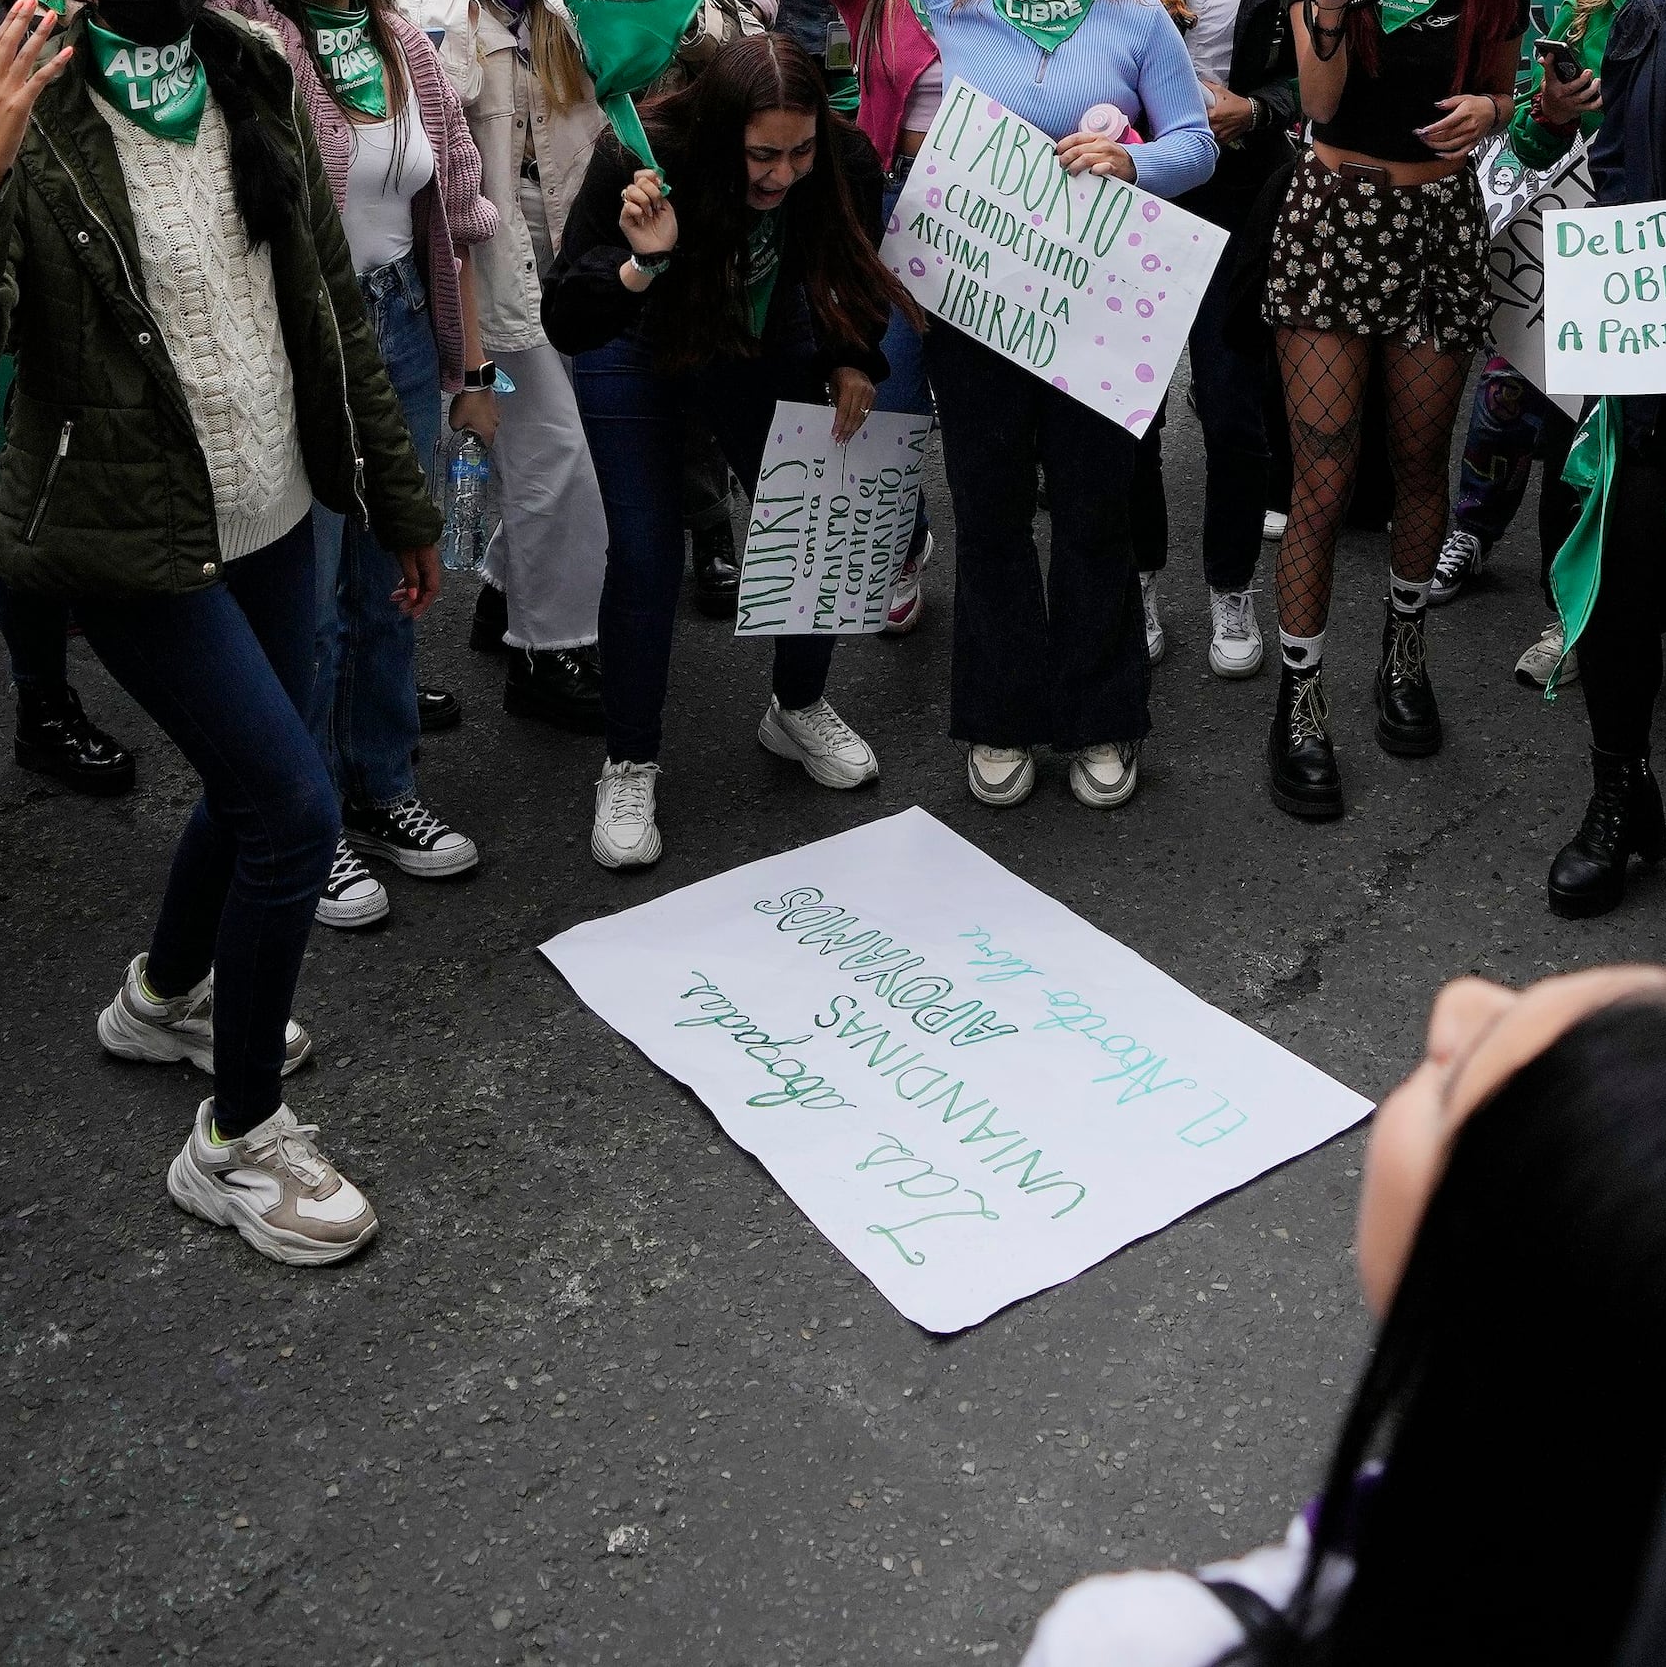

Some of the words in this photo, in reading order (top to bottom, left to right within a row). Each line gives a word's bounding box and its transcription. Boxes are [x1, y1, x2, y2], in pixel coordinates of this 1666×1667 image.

[128, 65, 196, 110] LIBRE
[968, 116, 1134, 258] ABORTO
[909, 212, 991, 279] ASESINA
[1039, 287, 1071, 325] LA
[938, 269, 1058, 369] LIBERTAD
[1557, 320, 1583, 352] A
[738, 460, 808, 632] MUJERES
[802, 494, 821, 579] contra
[845, 508, 872, 595] contra
[862, 468, 903, 631] TERRORISMO
[754, 886, 1020, 1047] APOYAMOS
[673, 970, 857, 1110] abogadas
[815, 993, 1088, 1220] UNIANDINAS
